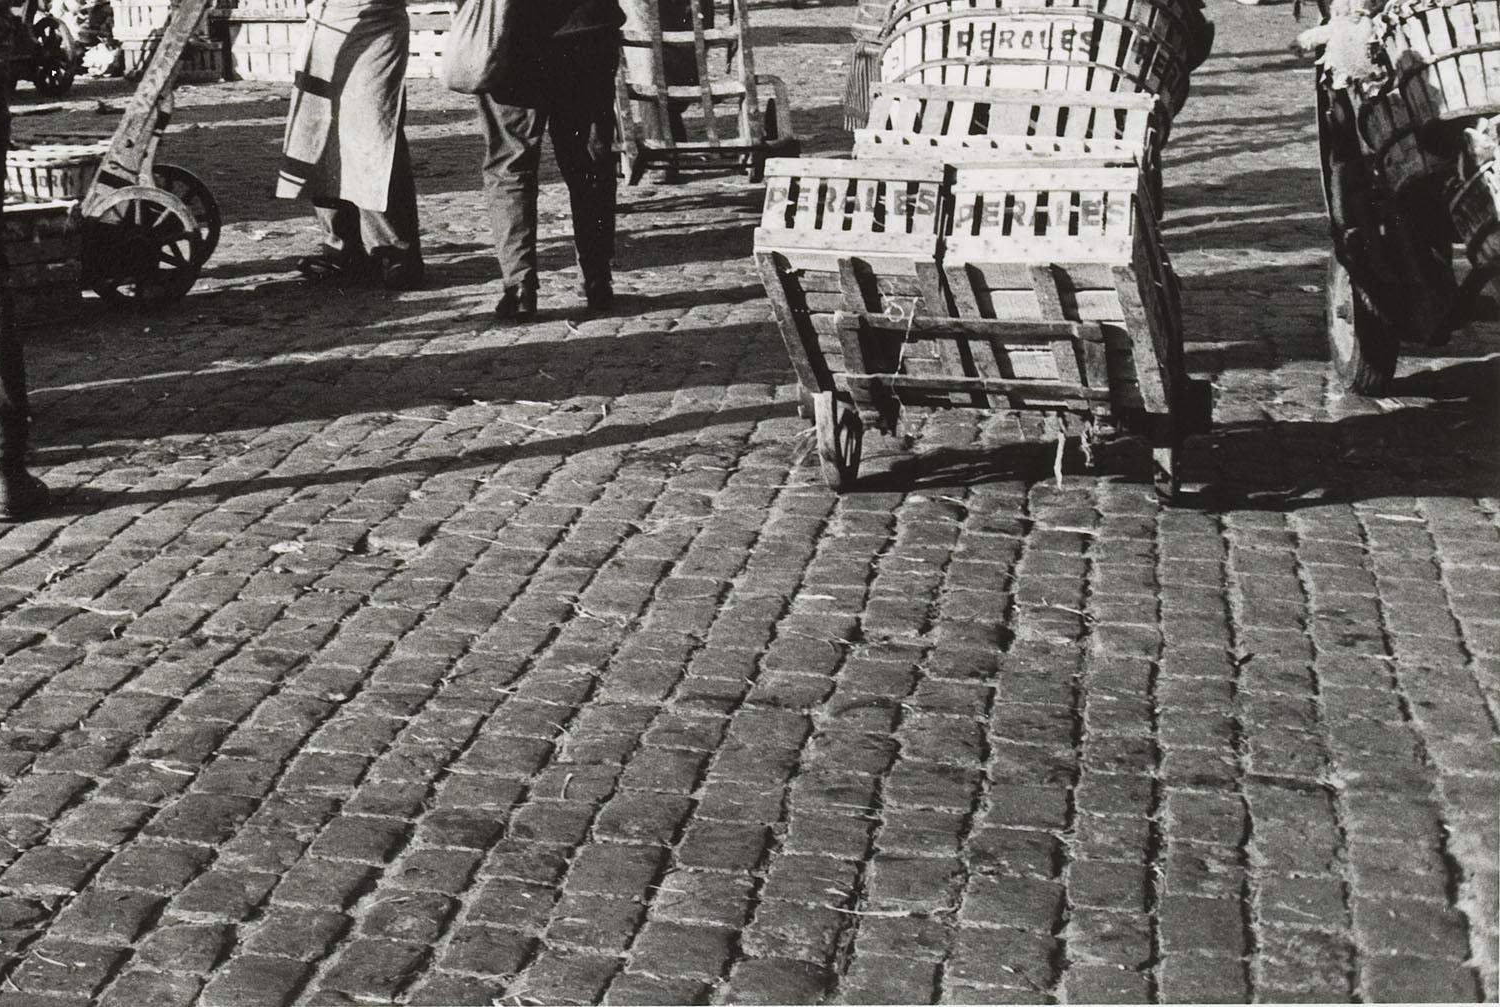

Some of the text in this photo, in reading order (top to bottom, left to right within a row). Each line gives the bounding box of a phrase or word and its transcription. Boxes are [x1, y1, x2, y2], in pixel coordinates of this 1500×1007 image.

[957, 28, 1093, 55] PERALES
[767, 186, 936, 216] PERALES
[956, 199, 1126, 228] PERALES
